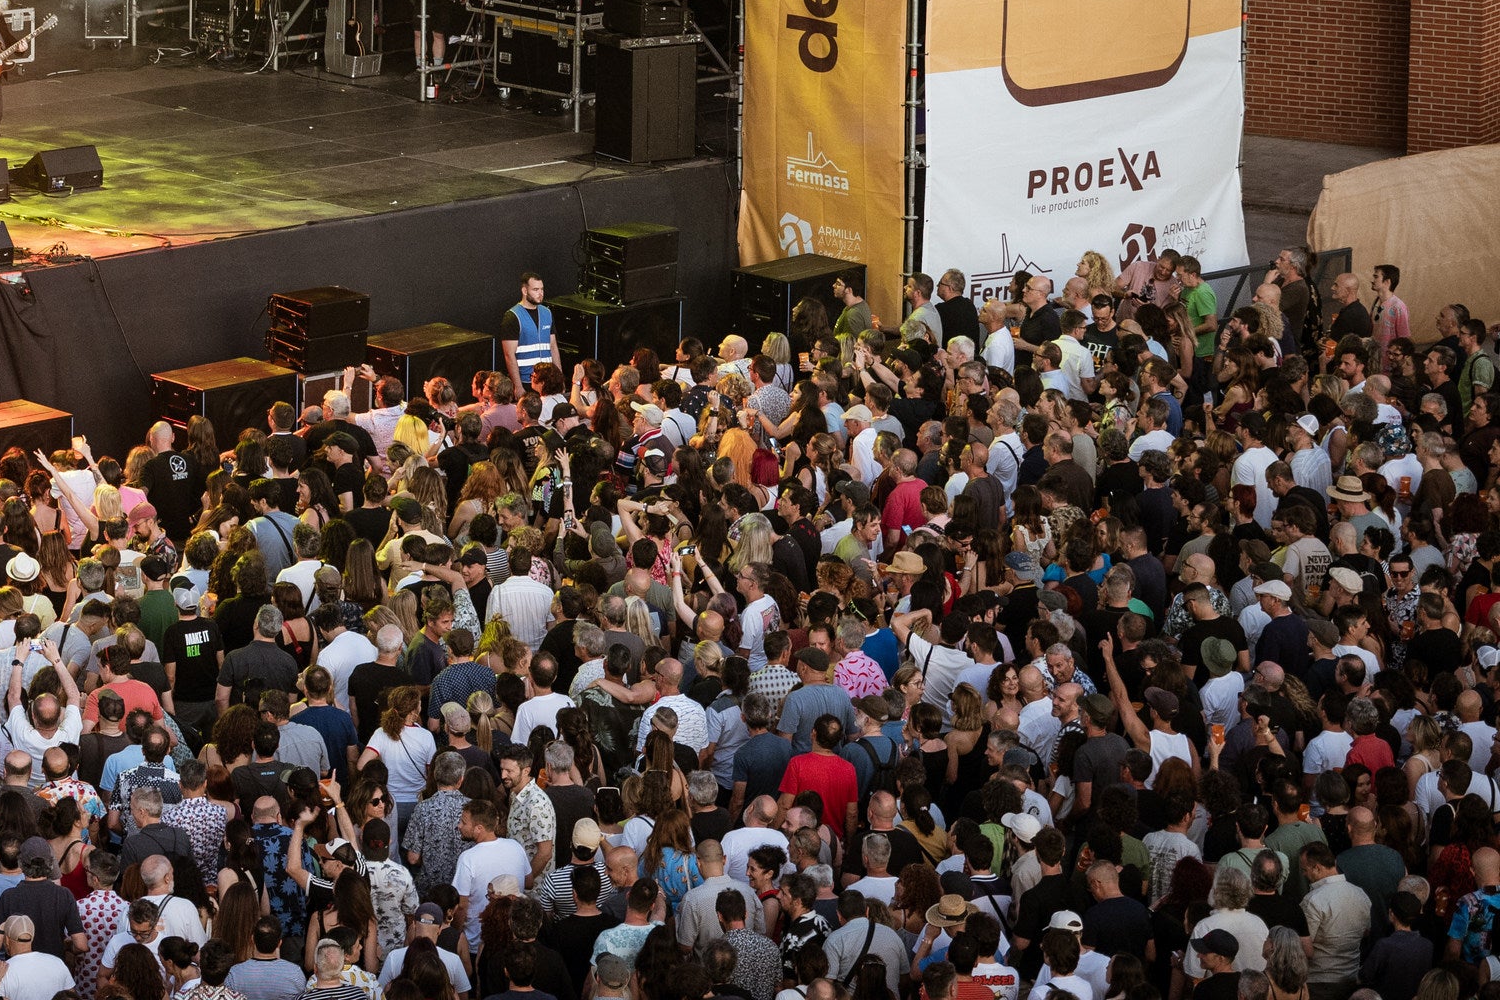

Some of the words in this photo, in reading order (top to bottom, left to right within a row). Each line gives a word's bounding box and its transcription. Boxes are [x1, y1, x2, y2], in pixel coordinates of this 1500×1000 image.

[787, 164, 849, 191] Fermasa
[1027, 147, 1162, 199] PROEXA
[1031, 202, 1047, 215] live
[1049, 197, 1100, 213] productions
[818, 226, 861, 241] ARMILLA
[1162, 217, 1207, 236] ARMILLA
[818, 237, 861, 252] AVANZA
[1162, 232, 1207, 250] AVANZA
[185, 631, 203, 646] MAKE
[202, 630, 210, 643] IT
[186, 644, 201, 657] REAL
